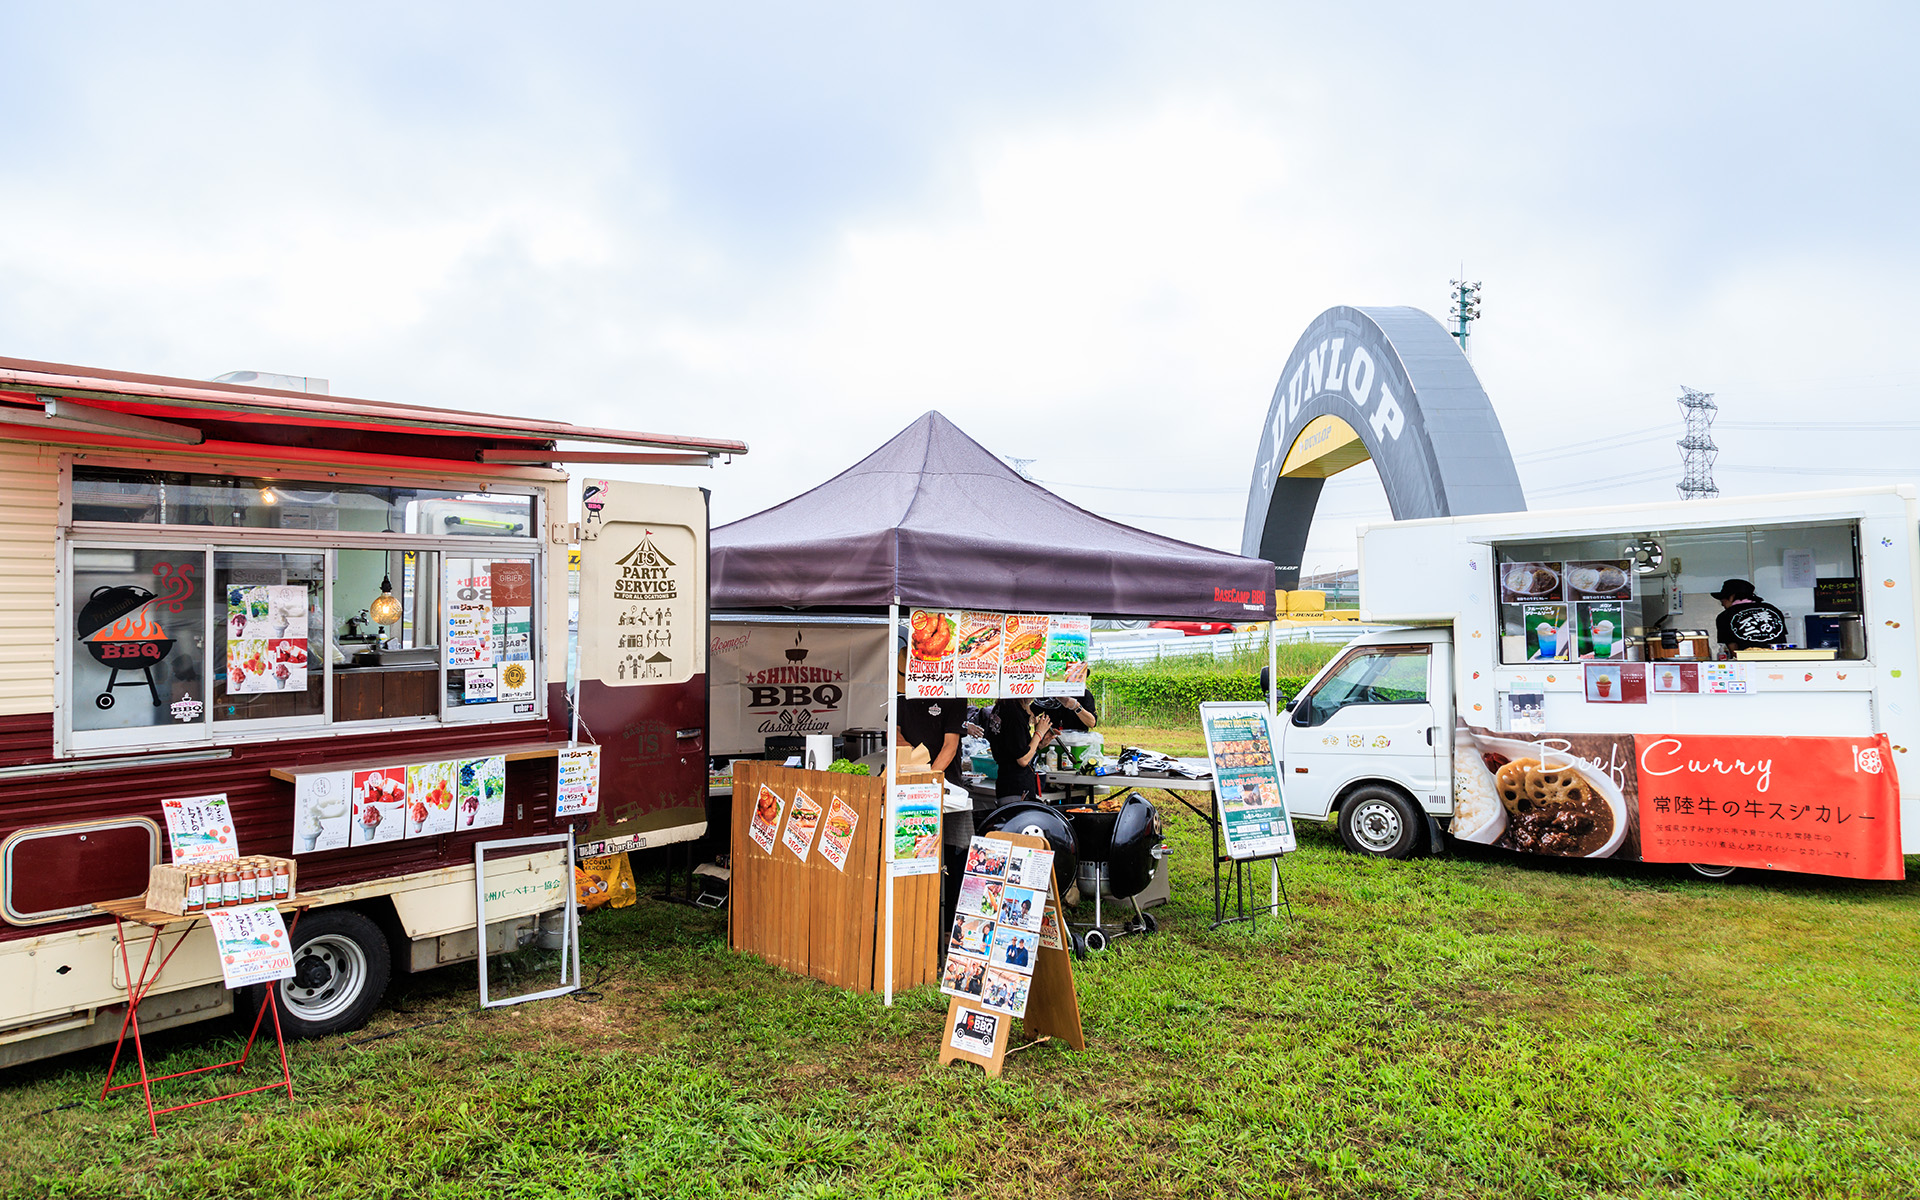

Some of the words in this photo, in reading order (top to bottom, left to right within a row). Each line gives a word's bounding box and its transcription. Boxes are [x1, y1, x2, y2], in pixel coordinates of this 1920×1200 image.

[1272, 337, 1405, 470] DUNLOP
[1304, 425, 1332, 451] DUNLOP
[637, 552, 655, 564] I'S
[500, 574, 523, 582] GIBIER
[622, 566, 669, 580] PARTY
[615, 579, 676, 593] SERVICE
[1251, 589, 1266, 607] BBQ
[92, 597, 134, 623] Premium
[101, 643, 161, 660] BBQ
[909, 659, 940, 674] CHICKEN
[940, 660, 954, 674] LEG
[958, 659, 976, 670] Chicken
[976, 658, 998, 671] Sandwich
[1004, 665, 1019, 674] Bacon
[1019, 662, 1043, 674] Sandwich
[756, 665, 833, 685] SHINSHU
[907, 673, 955, 683] スモークチキンレッグ
[917, 684, 944, 697] ¥800
[965, 682, 991, 695] ¥800
[1009, 683, 1035, 695] ¥800
[747, 684, 843, 709] BBQ
[757, 718, 830, 734] Association
[1528, 738, 1627, 792] Beef
[1641, 738, 1773, 793] Curry
[1653, 795, 1875, 824] 常陸牛の牛スジカレー
[607, 838, 647, 854] Char-Broil
[788, 837, 803, 854] ¥800
[824, 845, 840, 863] ¥800
[267, 957, 289, 969] ¥200
[974, 1019, 994, 1033] BBQ
